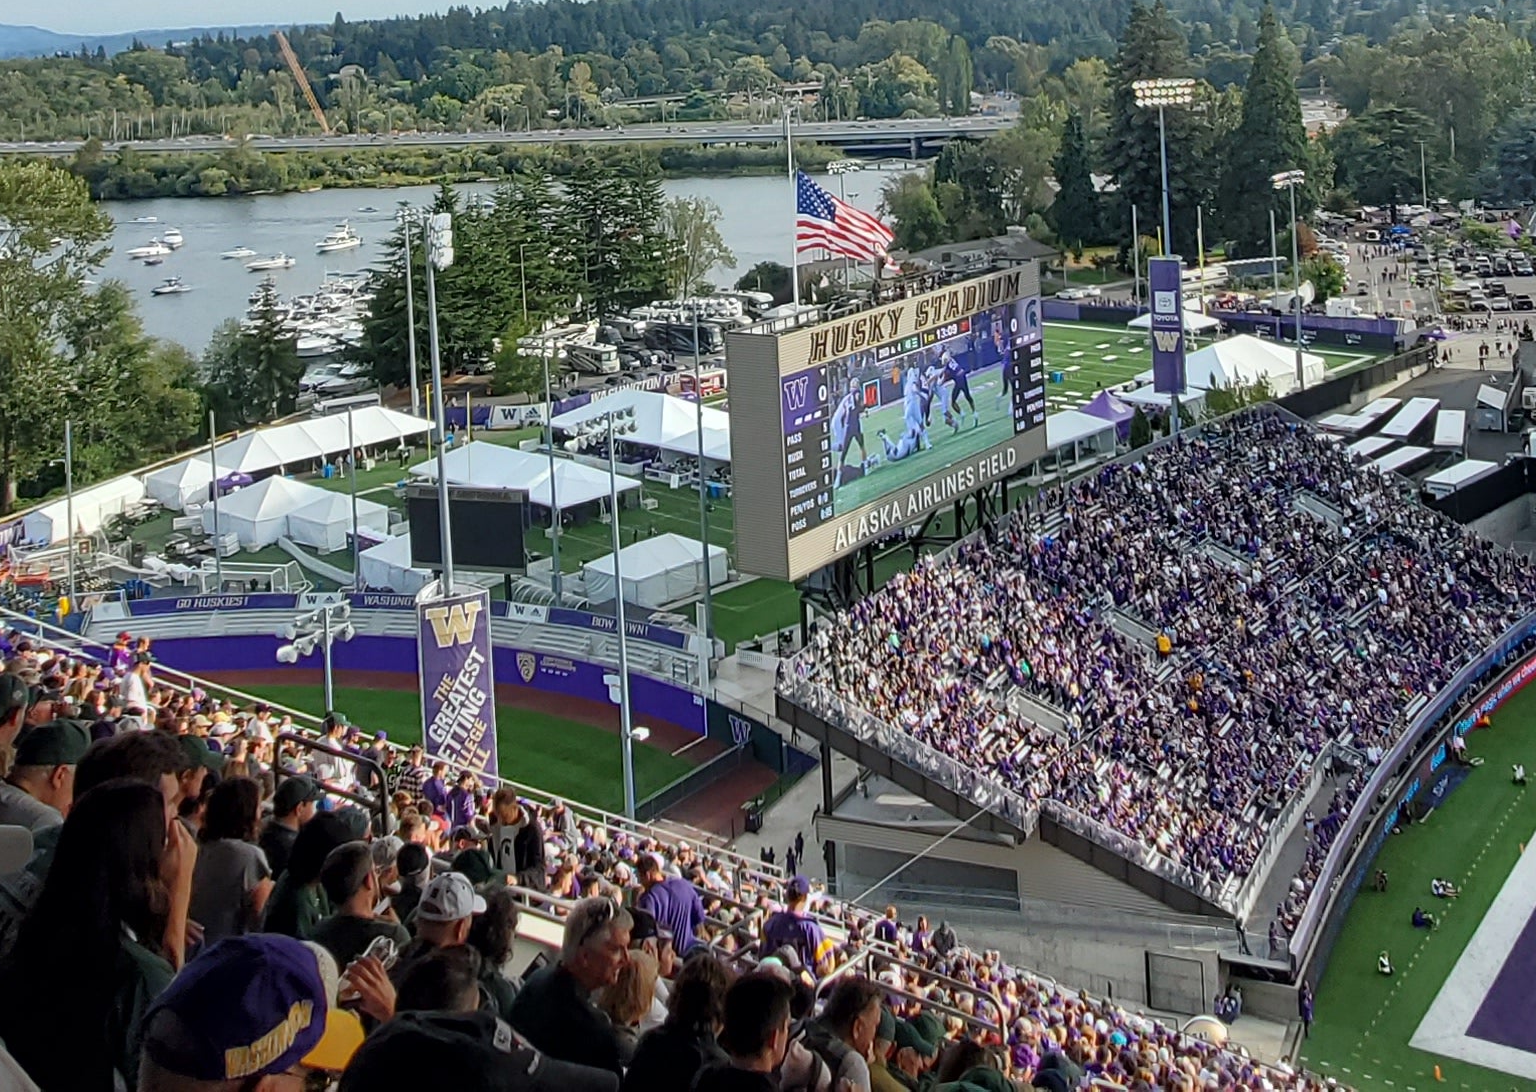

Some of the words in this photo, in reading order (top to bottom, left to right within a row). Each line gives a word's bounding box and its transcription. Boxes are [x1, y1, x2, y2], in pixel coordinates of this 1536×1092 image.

[808, 307, 904, 364] HUSKY
[915, 271, 1022, 330] STADIUM
[1153, 314, 1179, 322] TOYOTA
[936, 324, 957, 340] 13:09
[1153, 331, 1180, 352] W
[784, 376, 808, 410] W
[818, 385, 827, 402] 0
[501, 409, 516, 420] W
[786, 432, 802, 447] PASS
[788, 467, 807, 482] TOTAL
[834, 501, 902, 551] ALASKA
[907, 467, 974, 516] AIRLINES
[979, 448, 1016, 481] FIELD
[176, 598, 192, 608] GO
[306, 595, 318, 604] W
[514, 605, 525, 614] W
[425, 600, 483, 648] W
[592, 616, 614, 629] BOW
[1521, 658, 1536, 679] cheer
[428, 645, 485, 744] GREATEST
[433, 672, 455, 702] THE
[437, 686, 486, 763] ETTING
[728, 714, 751, 744] W
[225, 999, 314, 1079] WASHINGTON
